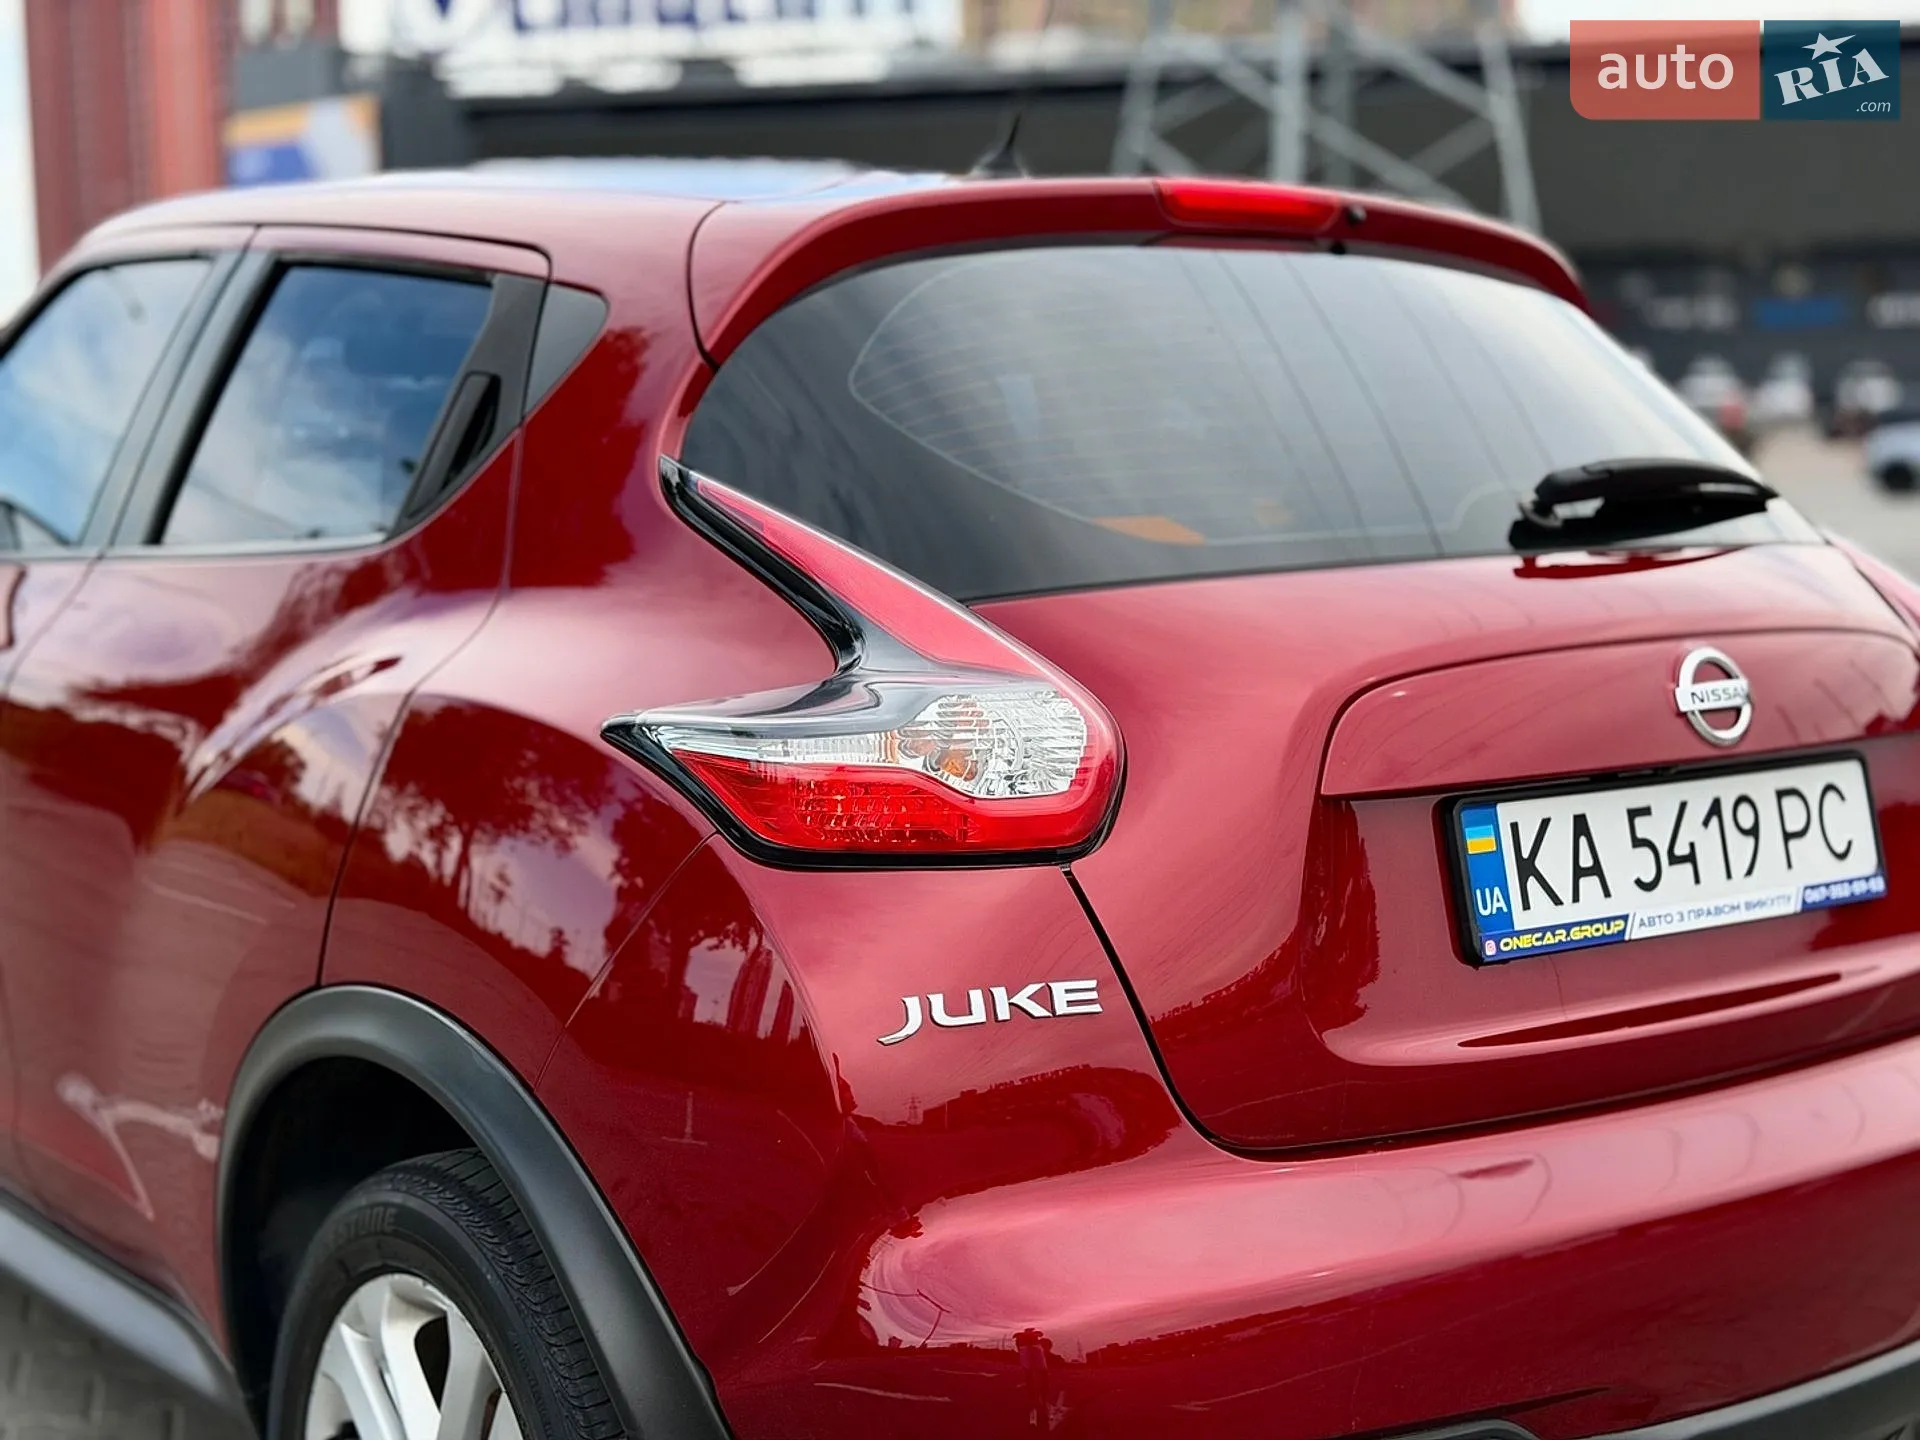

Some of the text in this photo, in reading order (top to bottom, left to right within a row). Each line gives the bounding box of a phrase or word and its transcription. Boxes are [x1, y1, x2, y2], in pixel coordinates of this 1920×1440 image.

[1510, 782, 1852, 911] KA 5419 PC
[1476, 886, 1508, 916] UA
[1638, 912, 1674, 929] АВТО
[1687, 902, 1740, 922] ПРАВОМ
[1500, 919, 1625, 952] ONECAR.GROUP
[877, 979, 1103, 1046] JUKE
